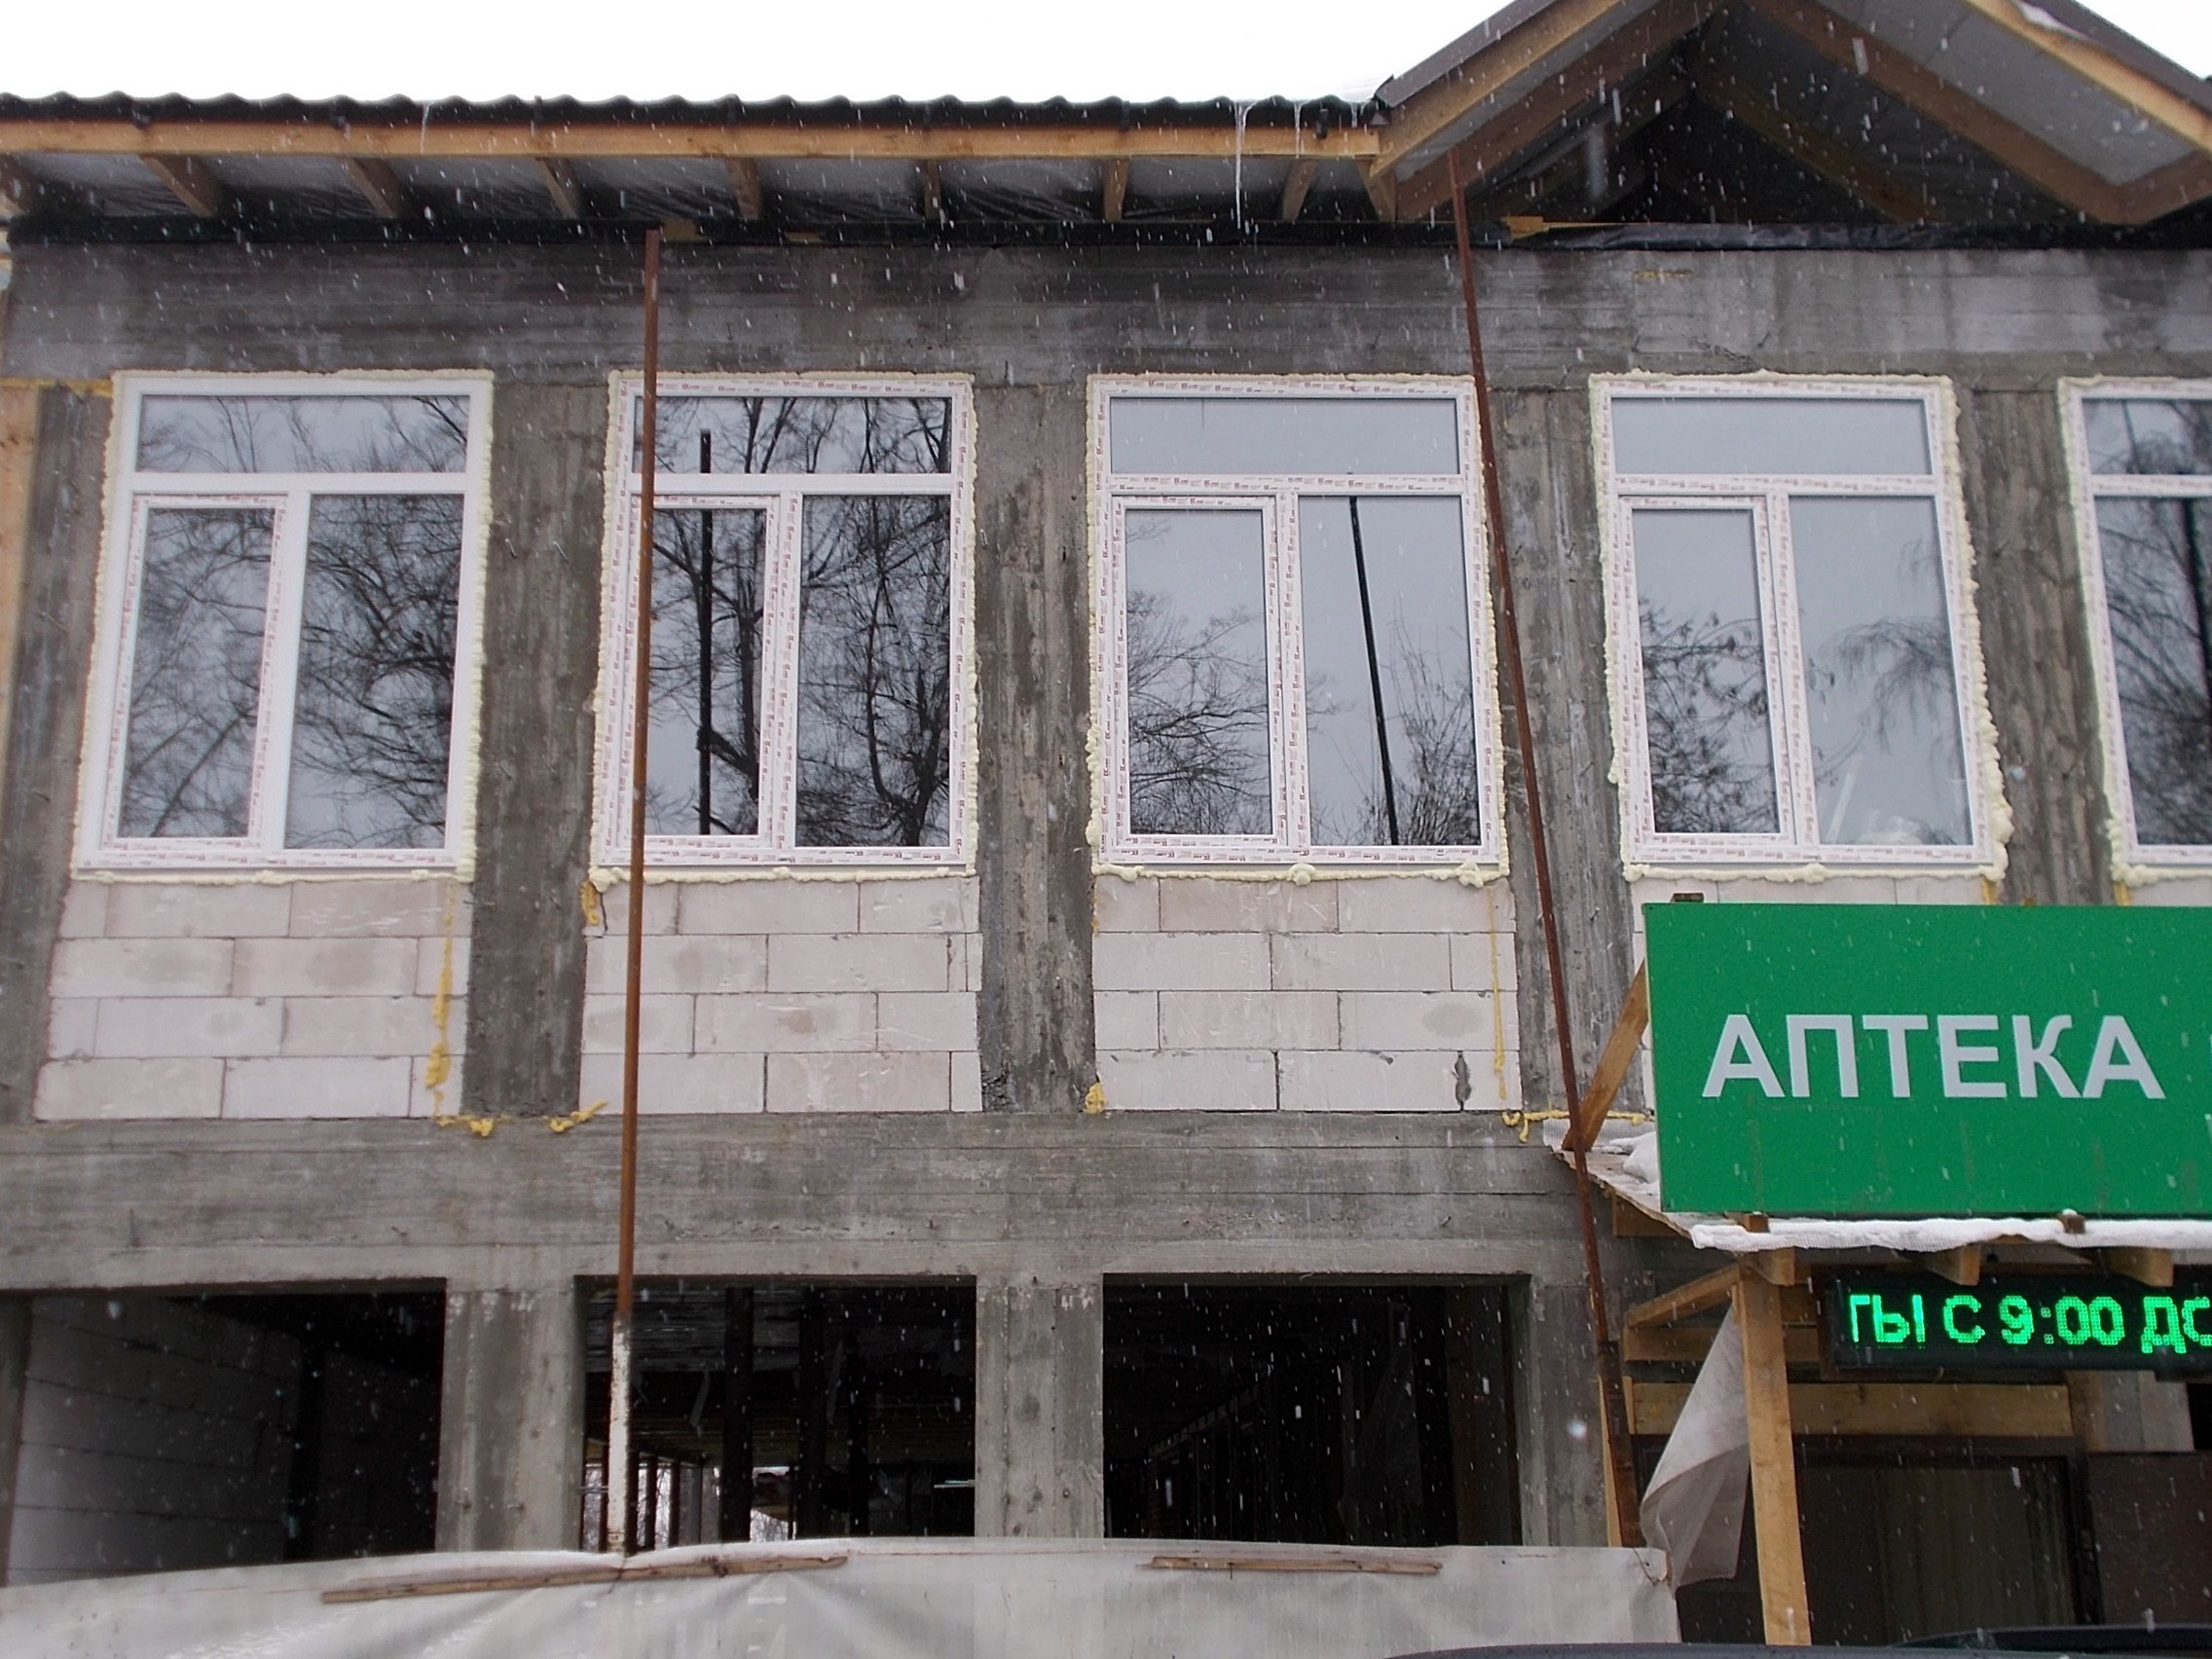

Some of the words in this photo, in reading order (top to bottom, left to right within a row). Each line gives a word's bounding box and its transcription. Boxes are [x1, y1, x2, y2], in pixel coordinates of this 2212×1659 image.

[1702, 1014, 2166, 1099] АПТЕКА
[1943, 1294, 1986, 1344] С
[1999, 1295, 2125, 1346] 9:00
